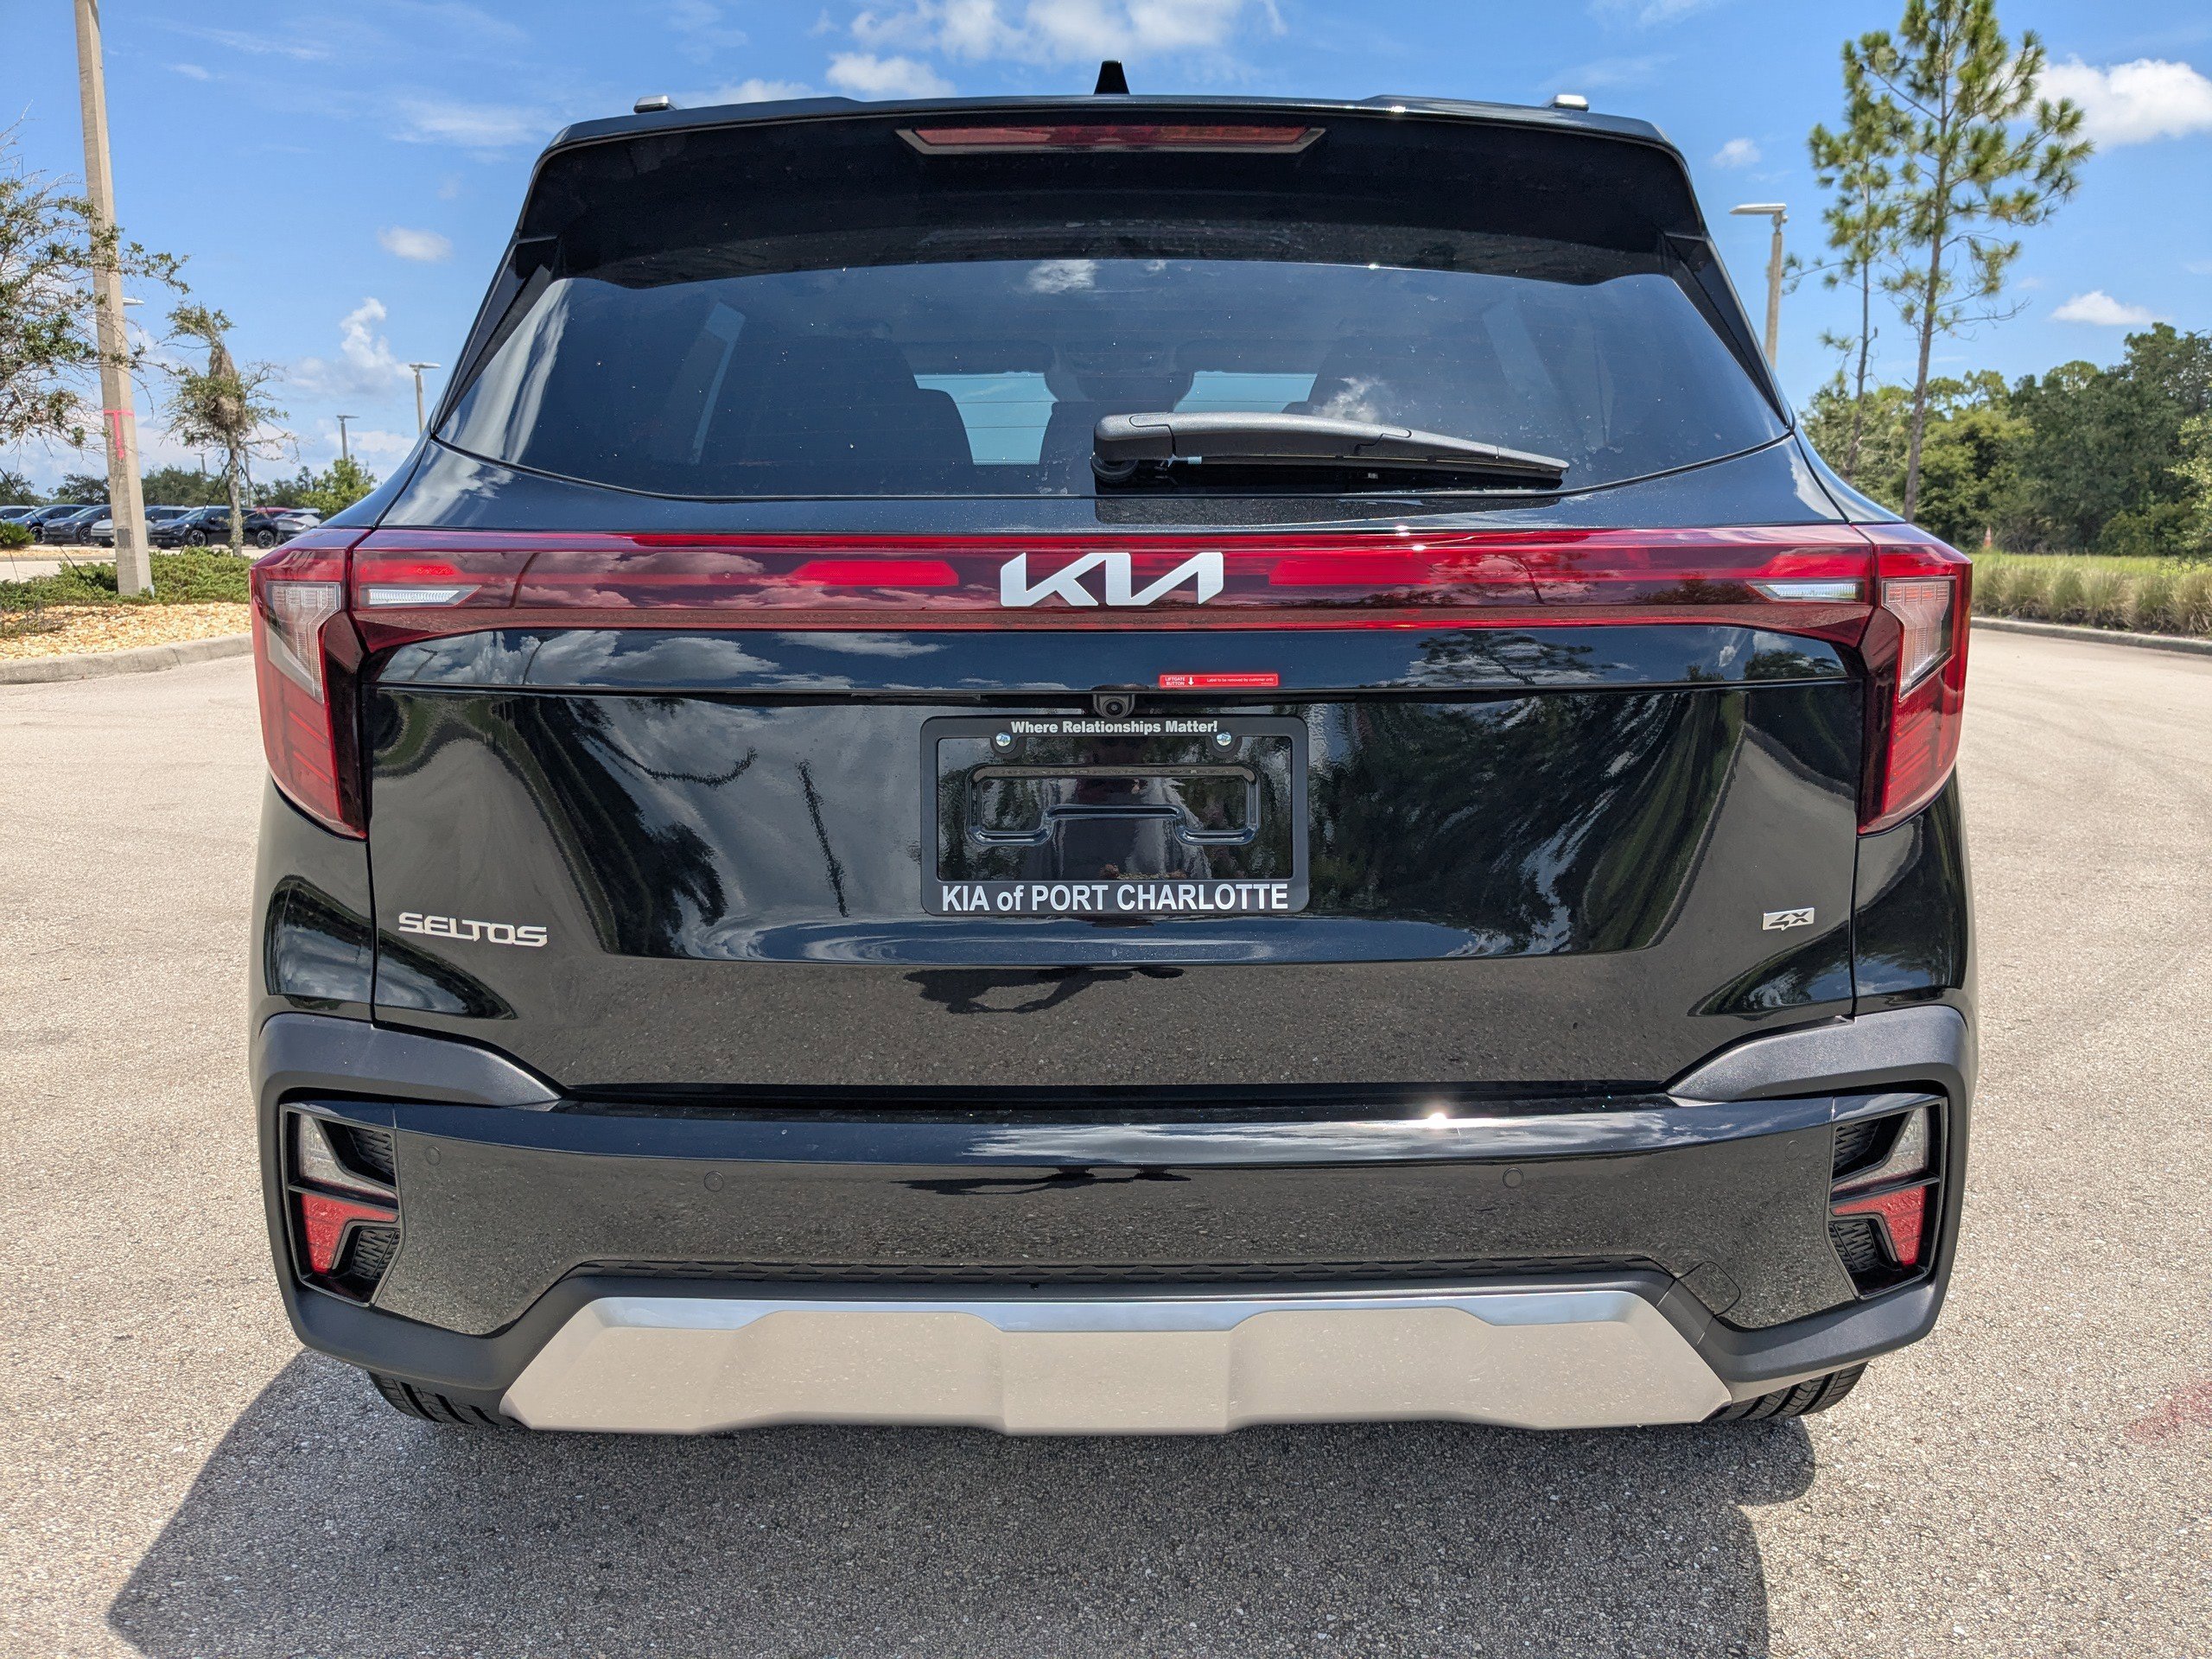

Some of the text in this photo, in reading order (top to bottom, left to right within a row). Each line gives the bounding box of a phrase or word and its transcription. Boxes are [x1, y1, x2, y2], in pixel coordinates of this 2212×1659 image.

[1001, 552, 1224, 607] KIA
[1011, 721, 1217, 735] Where Relationships Matter!
[942, 883, 1288, 912] KIA of PORT CHARLOTTE
[398, 912, 548, 948] SELTOS
